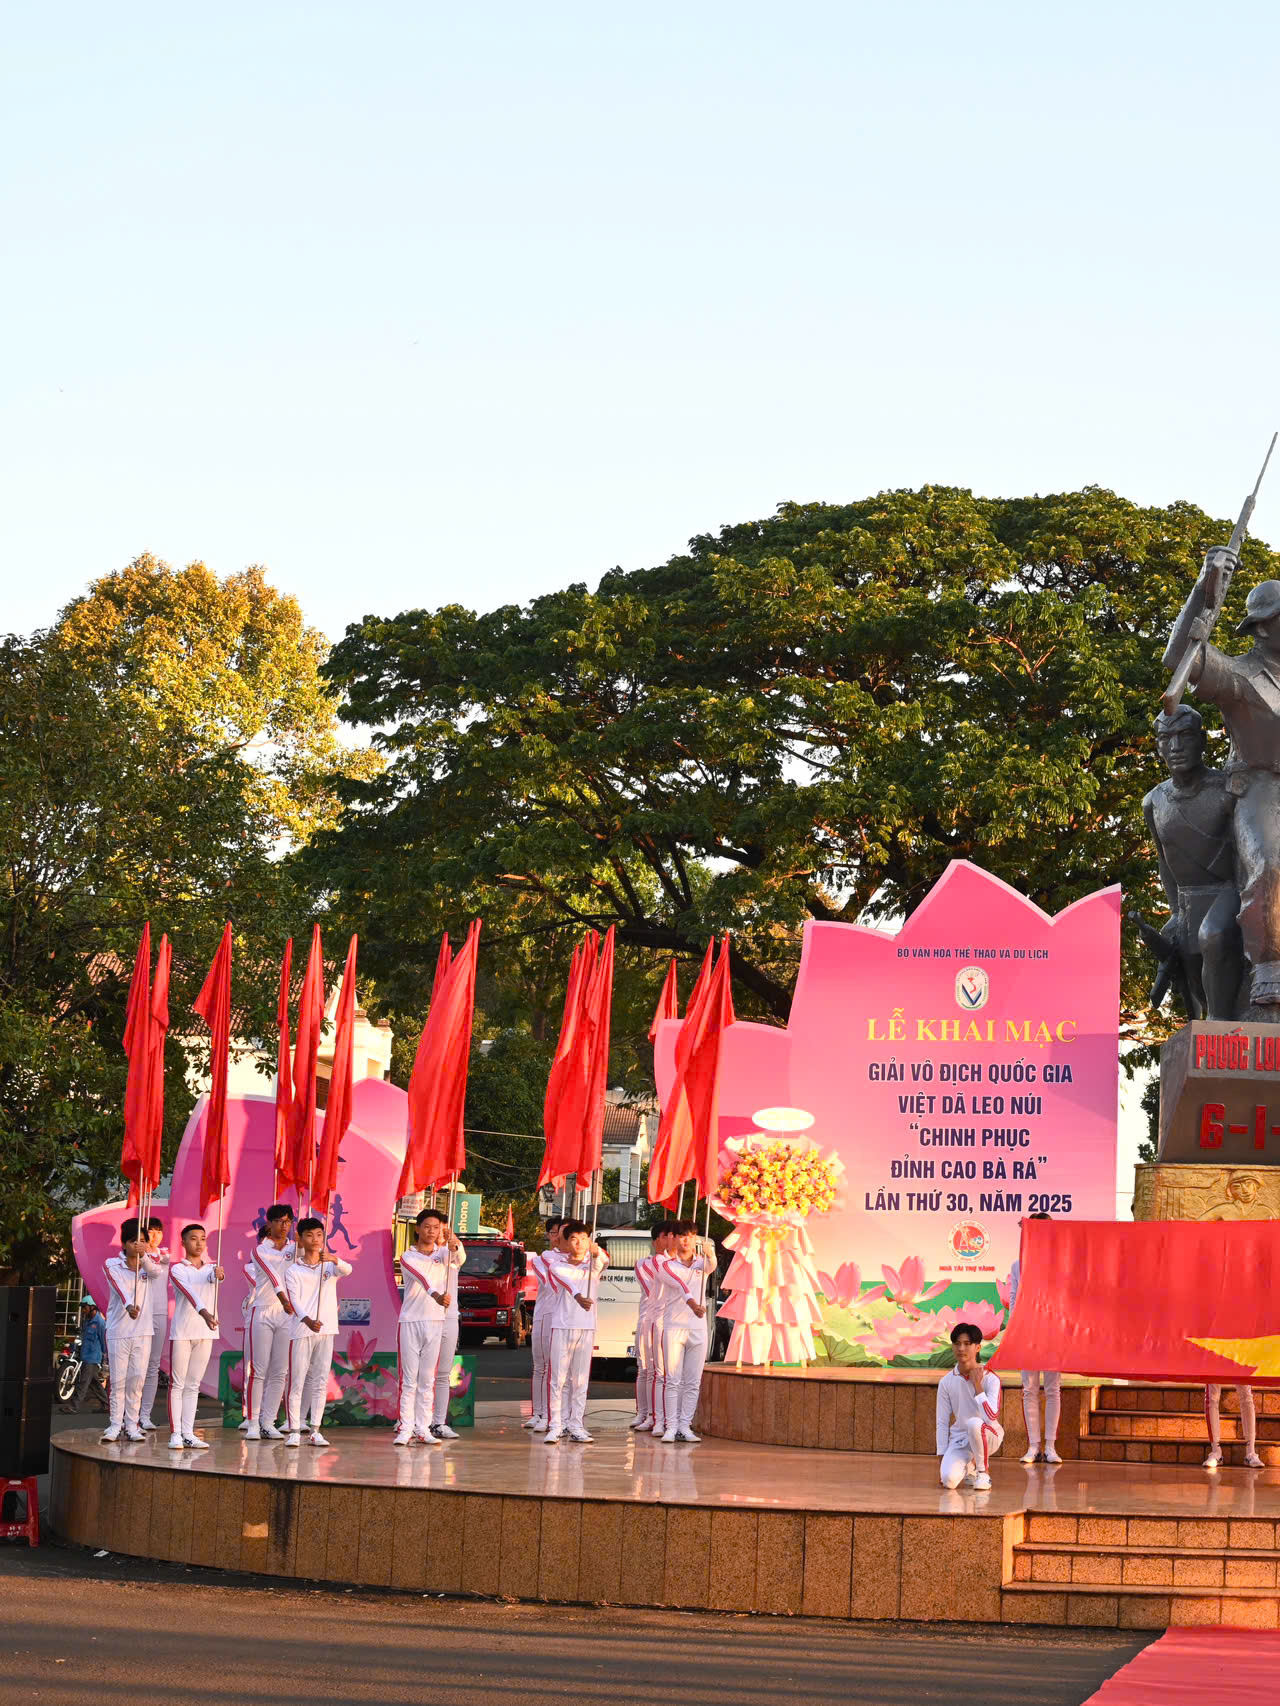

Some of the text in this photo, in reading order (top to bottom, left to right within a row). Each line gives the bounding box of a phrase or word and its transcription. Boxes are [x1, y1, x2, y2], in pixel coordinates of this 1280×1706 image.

[897, 946, 1048, 960] BỘ VĂN HÓA THỂ THAO VÀ DU LỊCH
[866, 1007, 1077, 1048] LỄ KHAI MẠC
[1195, 1027, 1249, 1070] PHƯỚC
[868, 1057, 1073, 1085] GIẢI VÔ ĐỊCH QUỐC GIA
[898, 1091, 1042, 1117] VIỆT DÃ LEO NÚI
[910, 1123, 1030, 1151] “CHINH PHỤC
[890, 1154, 1047, 1180] ĐỈNH CAO BÀ RÁ”
[865, 1186, 1072, 1214] LẦN THỨ 30, NĂM 2025
